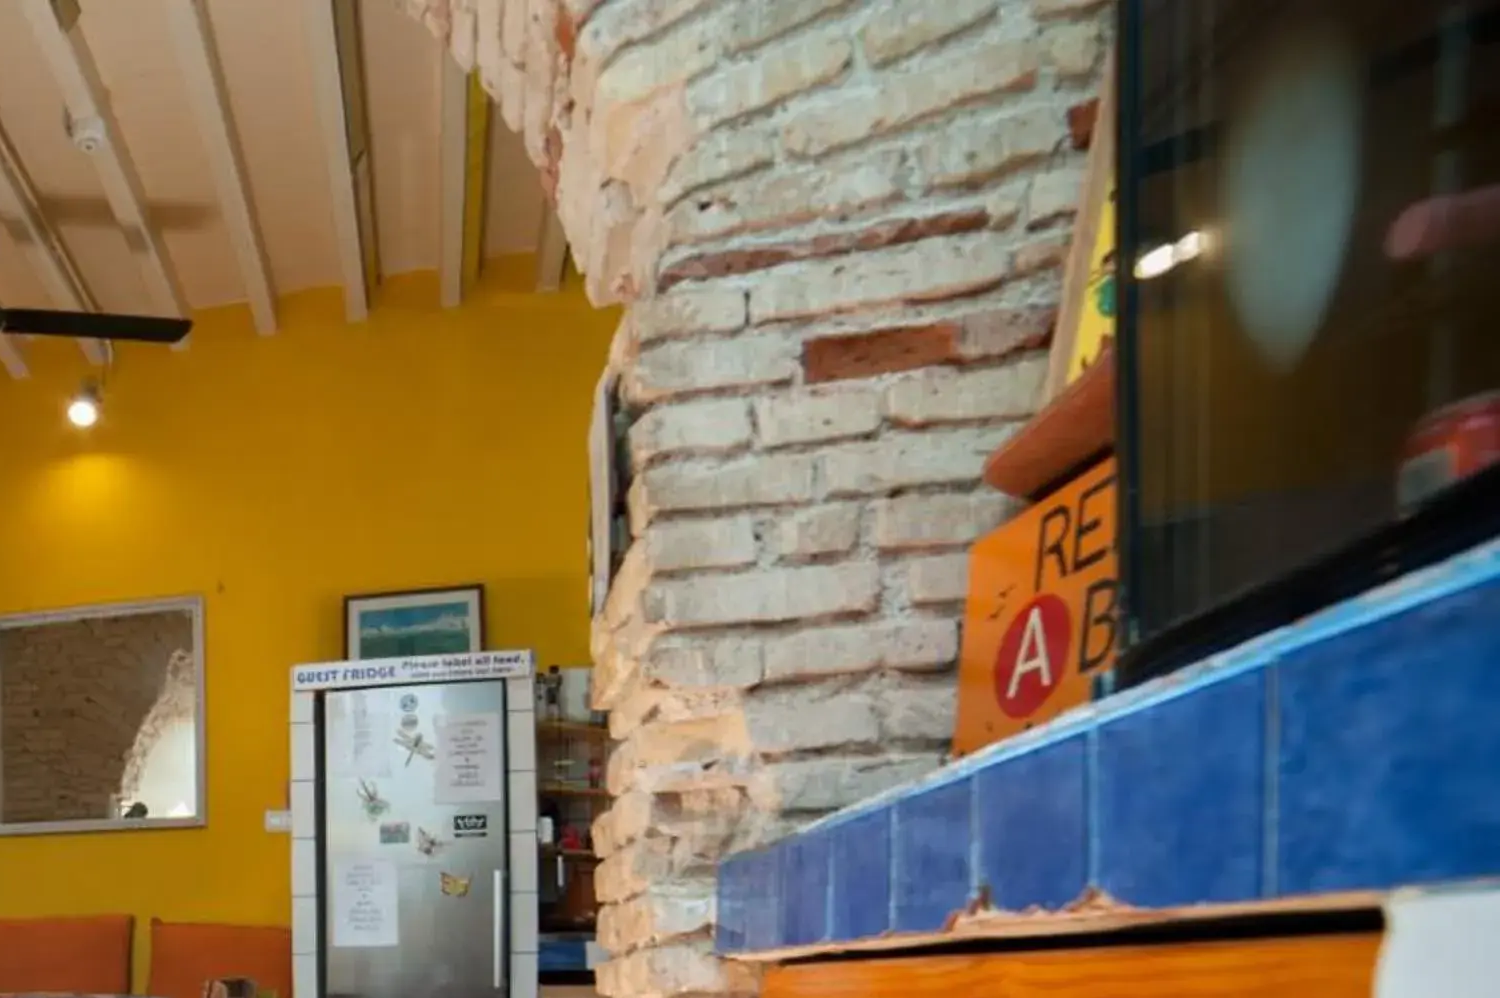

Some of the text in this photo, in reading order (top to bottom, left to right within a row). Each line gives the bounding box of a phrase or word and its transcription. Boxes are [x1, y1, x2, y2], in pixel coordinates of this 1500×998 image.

[1035, 474, 1117, 592] RE
[297, 669, 339, 683] GUEST
[342, 665, 396, 680] FRIDGE
[401, 658, 439, 670] Please
[441, 656, 472, 668] label
[474, 654, 491, 666] all
[1006, 606, 1052, 699] A
